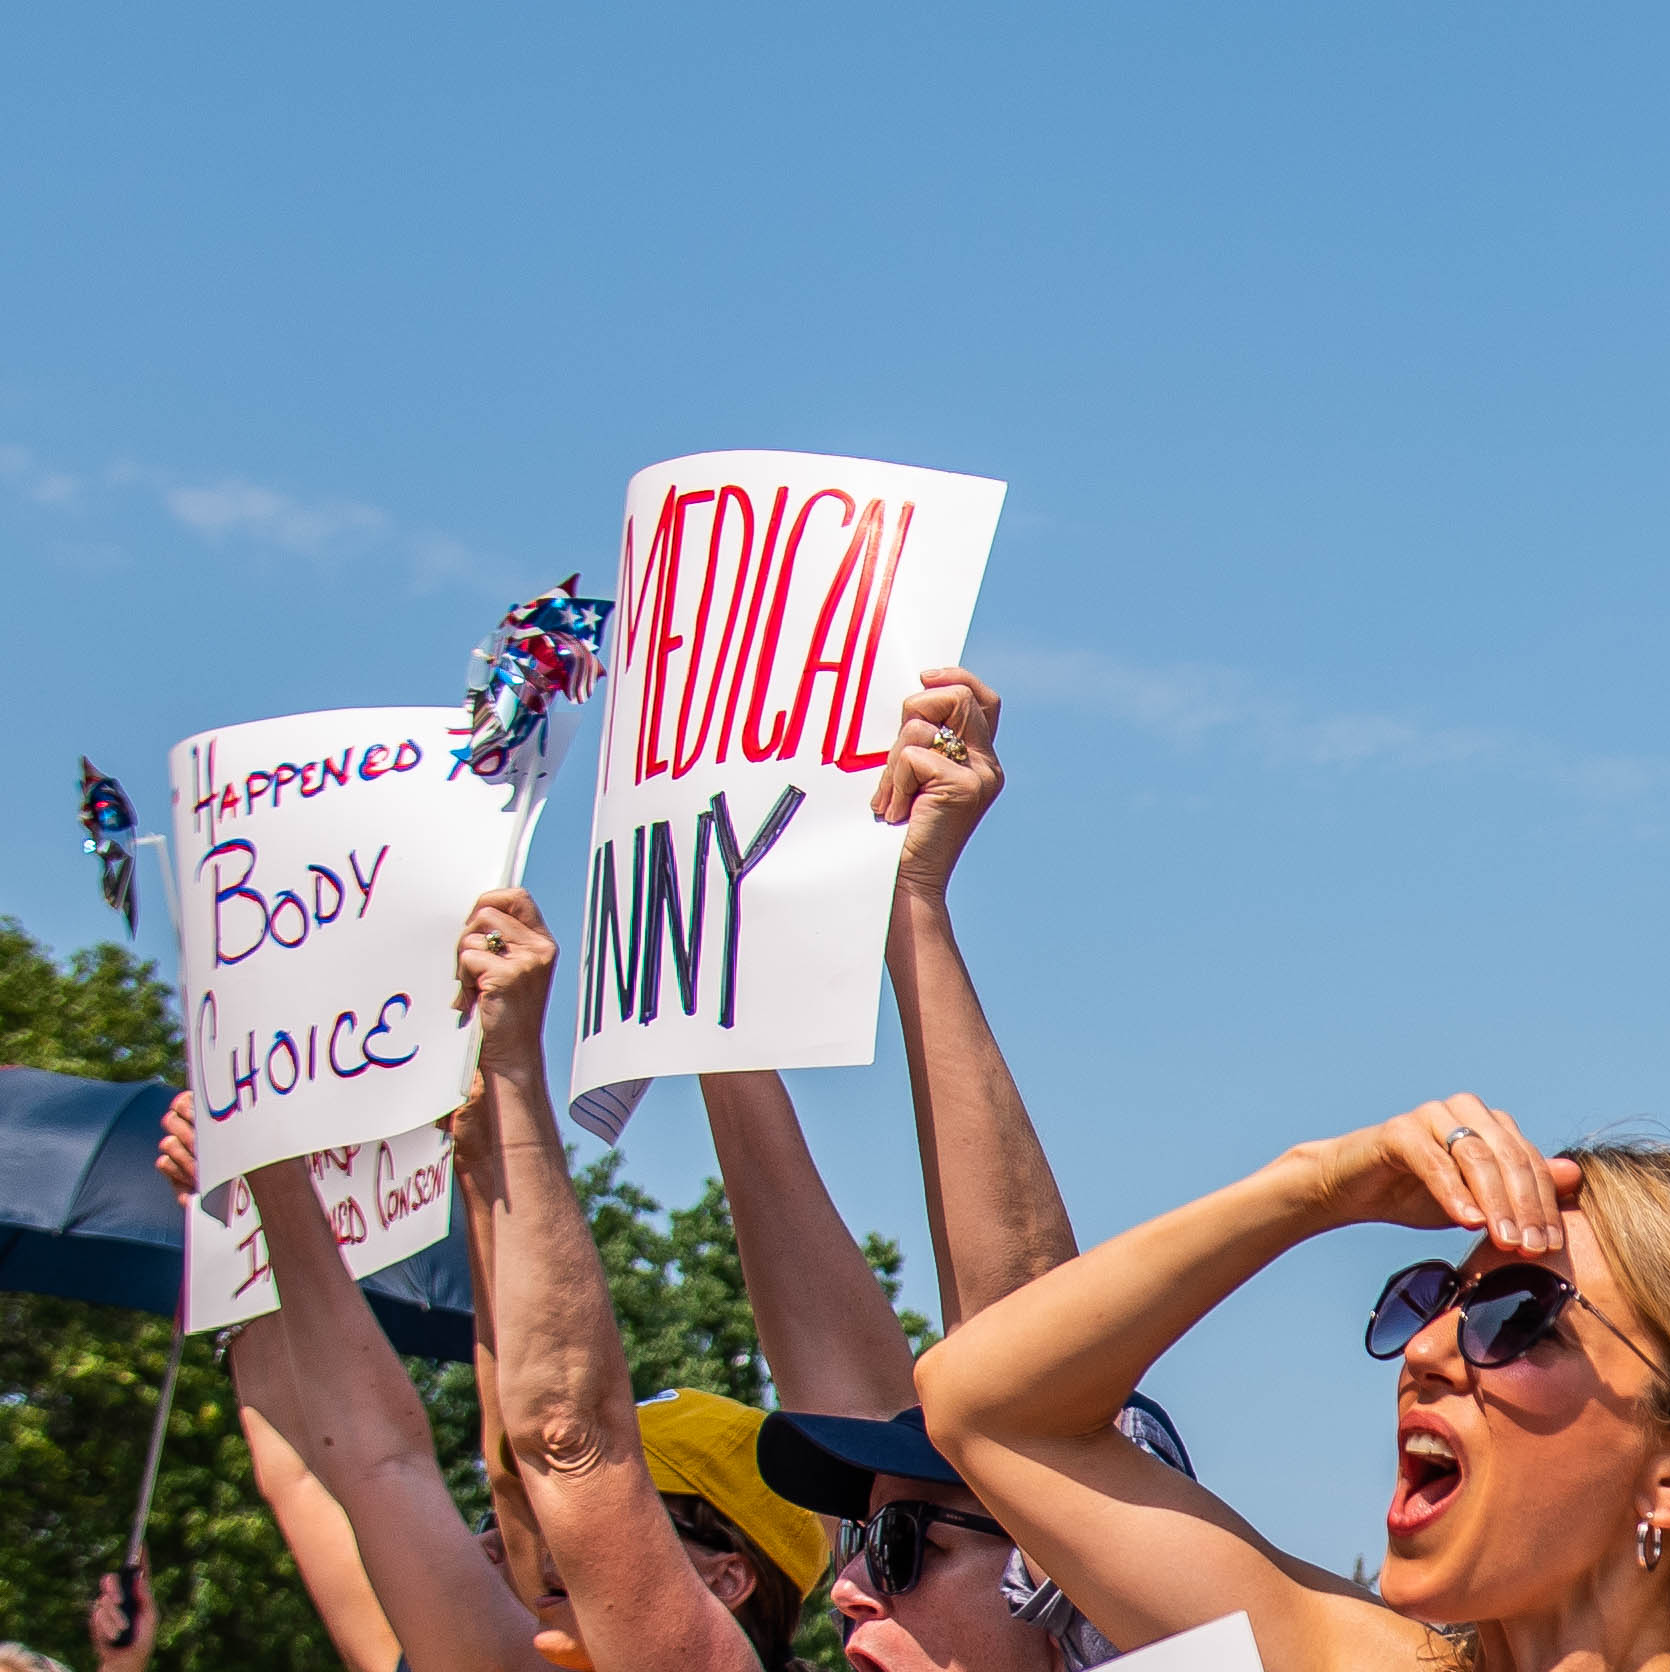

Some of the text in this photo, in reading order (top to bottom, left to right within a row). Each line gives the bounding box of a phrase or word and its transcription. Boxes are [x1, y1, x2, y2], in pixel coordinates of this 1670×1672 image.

[602, 484, 916, 797] MEDICAL
[194, 735, 423, 847] HAPPENED
[200, 837, 392, 970] BODY
[200, 988, 420, 1122] CHOICE
